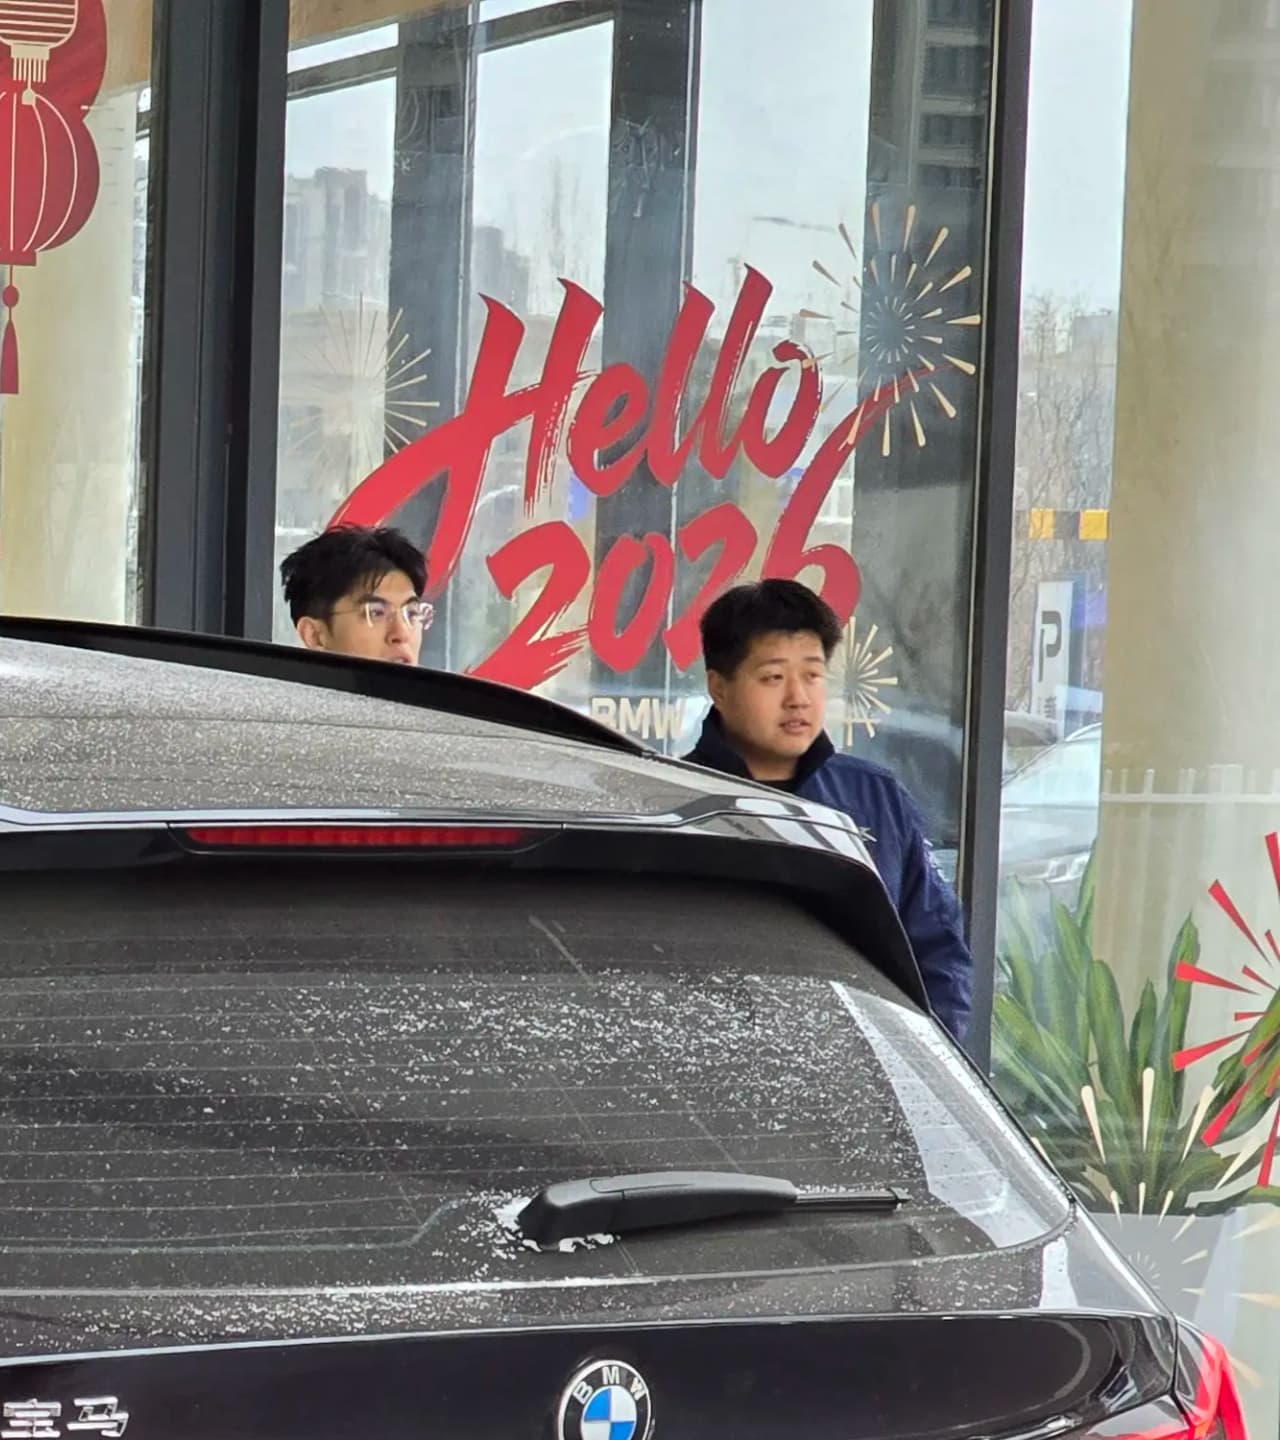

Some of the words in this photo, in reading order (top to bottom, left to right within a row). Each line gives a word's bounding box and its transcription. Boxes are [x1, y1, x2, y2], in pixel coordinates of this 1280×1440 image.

[324, 263, 824, 600] Hello
[460, 360, 955, 692] 2026
[1037, 610, 1062, 683] P
[572, 1366, 647, 1405] BMW
